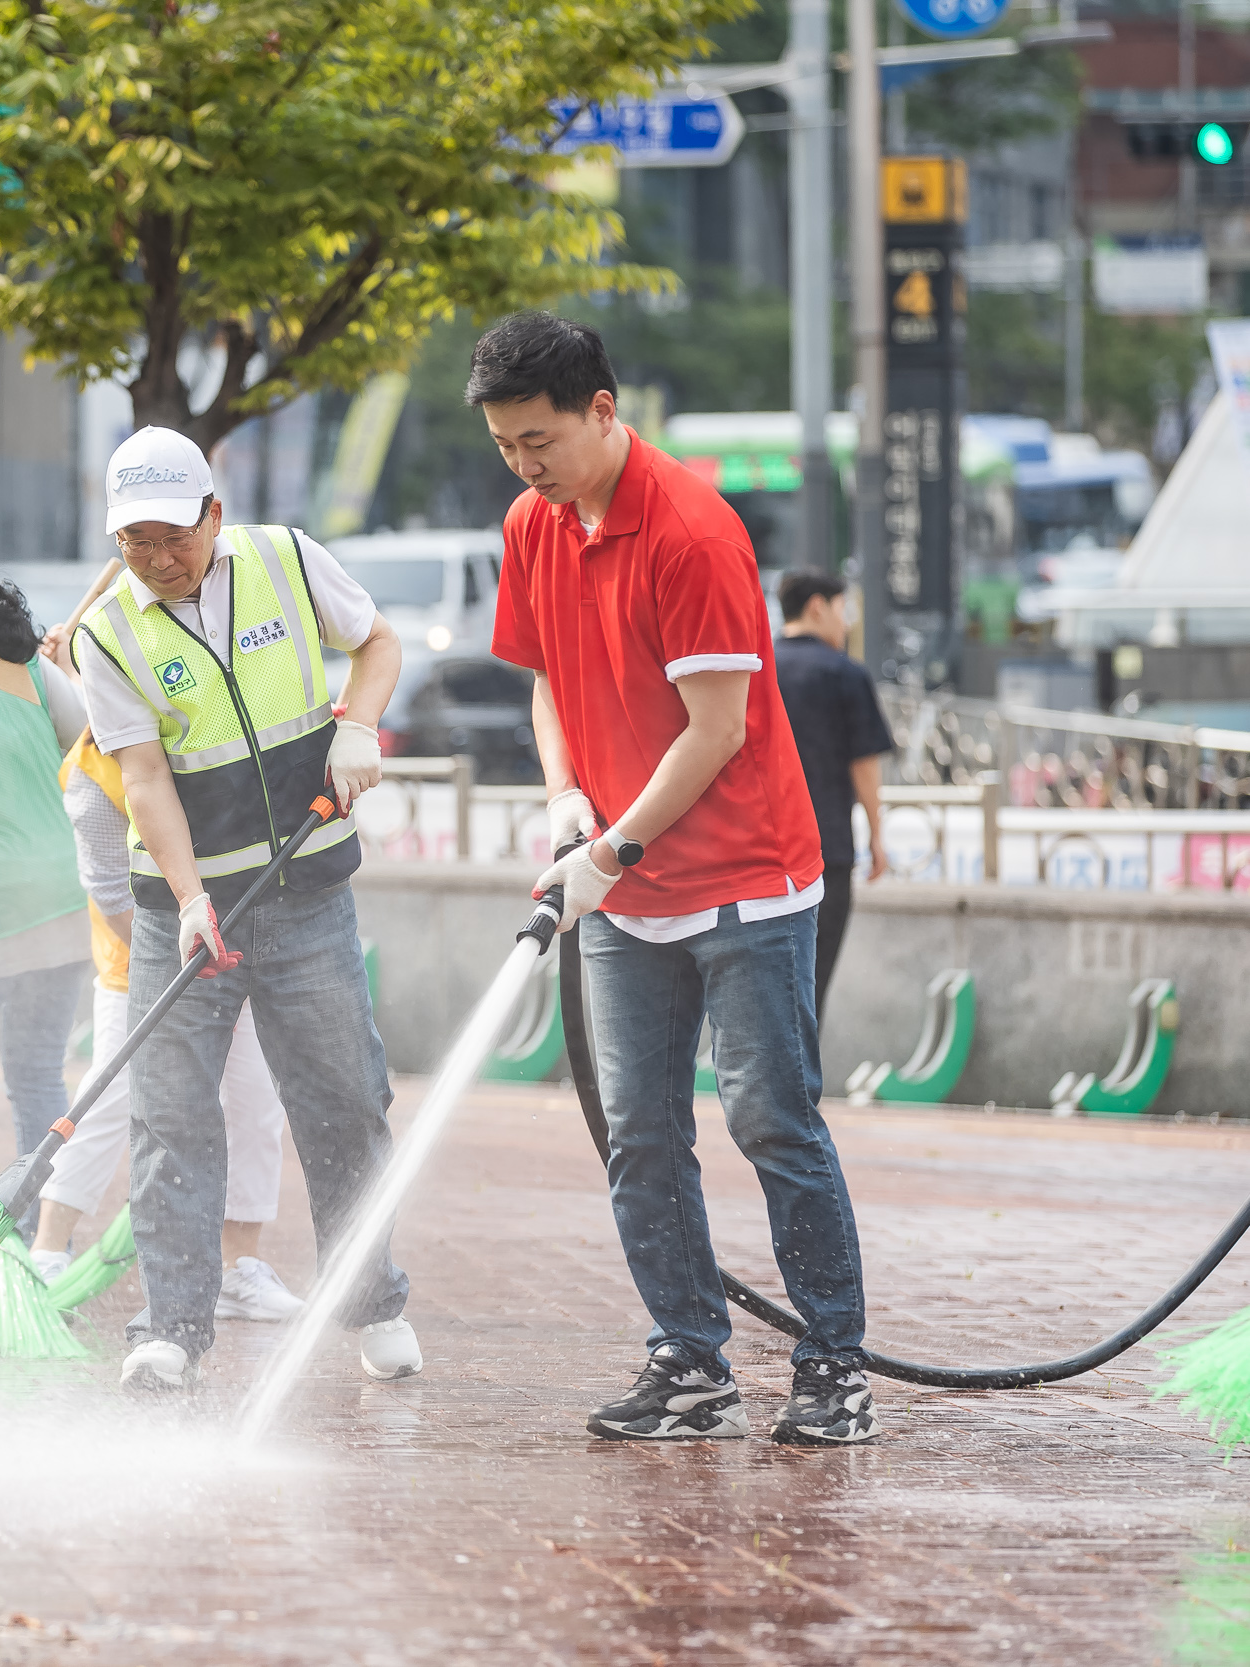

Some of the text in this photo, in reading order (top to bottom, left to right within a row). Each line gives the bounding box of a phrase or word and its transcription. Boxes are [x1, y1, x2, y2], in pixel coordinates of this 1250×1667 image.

[892, 270, 937, 319] 4
[113, 464, 188, 493] Titleist
[253, 629, 285, 647] 광진구청장
[167, 678, 191, 693] 광진구
